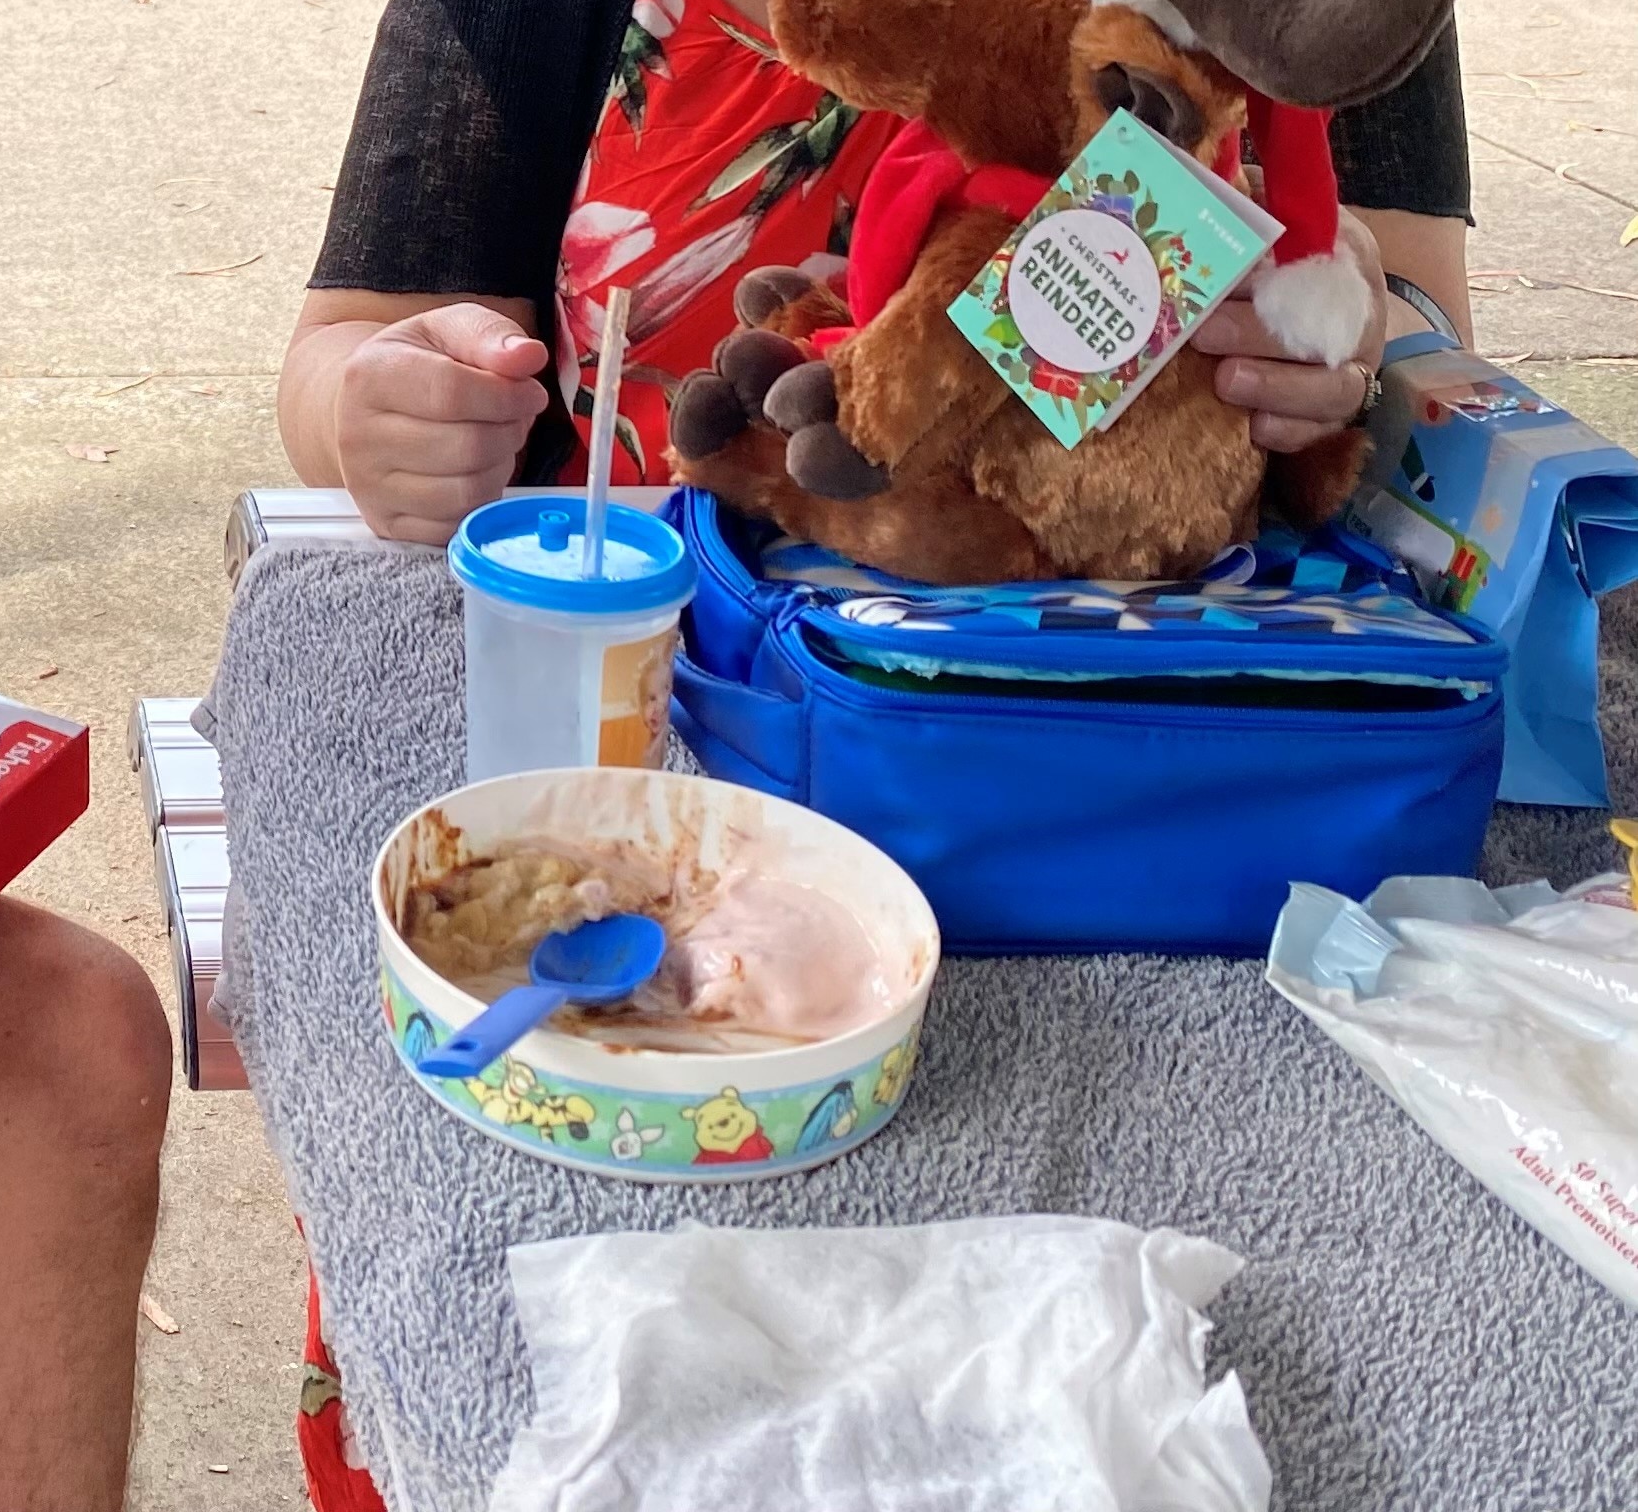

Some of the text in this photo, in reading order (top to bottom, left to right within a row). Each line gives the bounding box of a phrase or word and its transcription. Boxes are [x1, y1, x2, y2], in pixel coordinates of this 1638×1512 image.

[1032, 236, 1136, 342] ANIMATED
[1068, 234, 1137, 305] CHRISTMAS
[1019, 257, 1117, 361] REINDEER
[1509, 1146, 1555, 1186] Adult
[1573, 1161, 1597, 1181] 50
